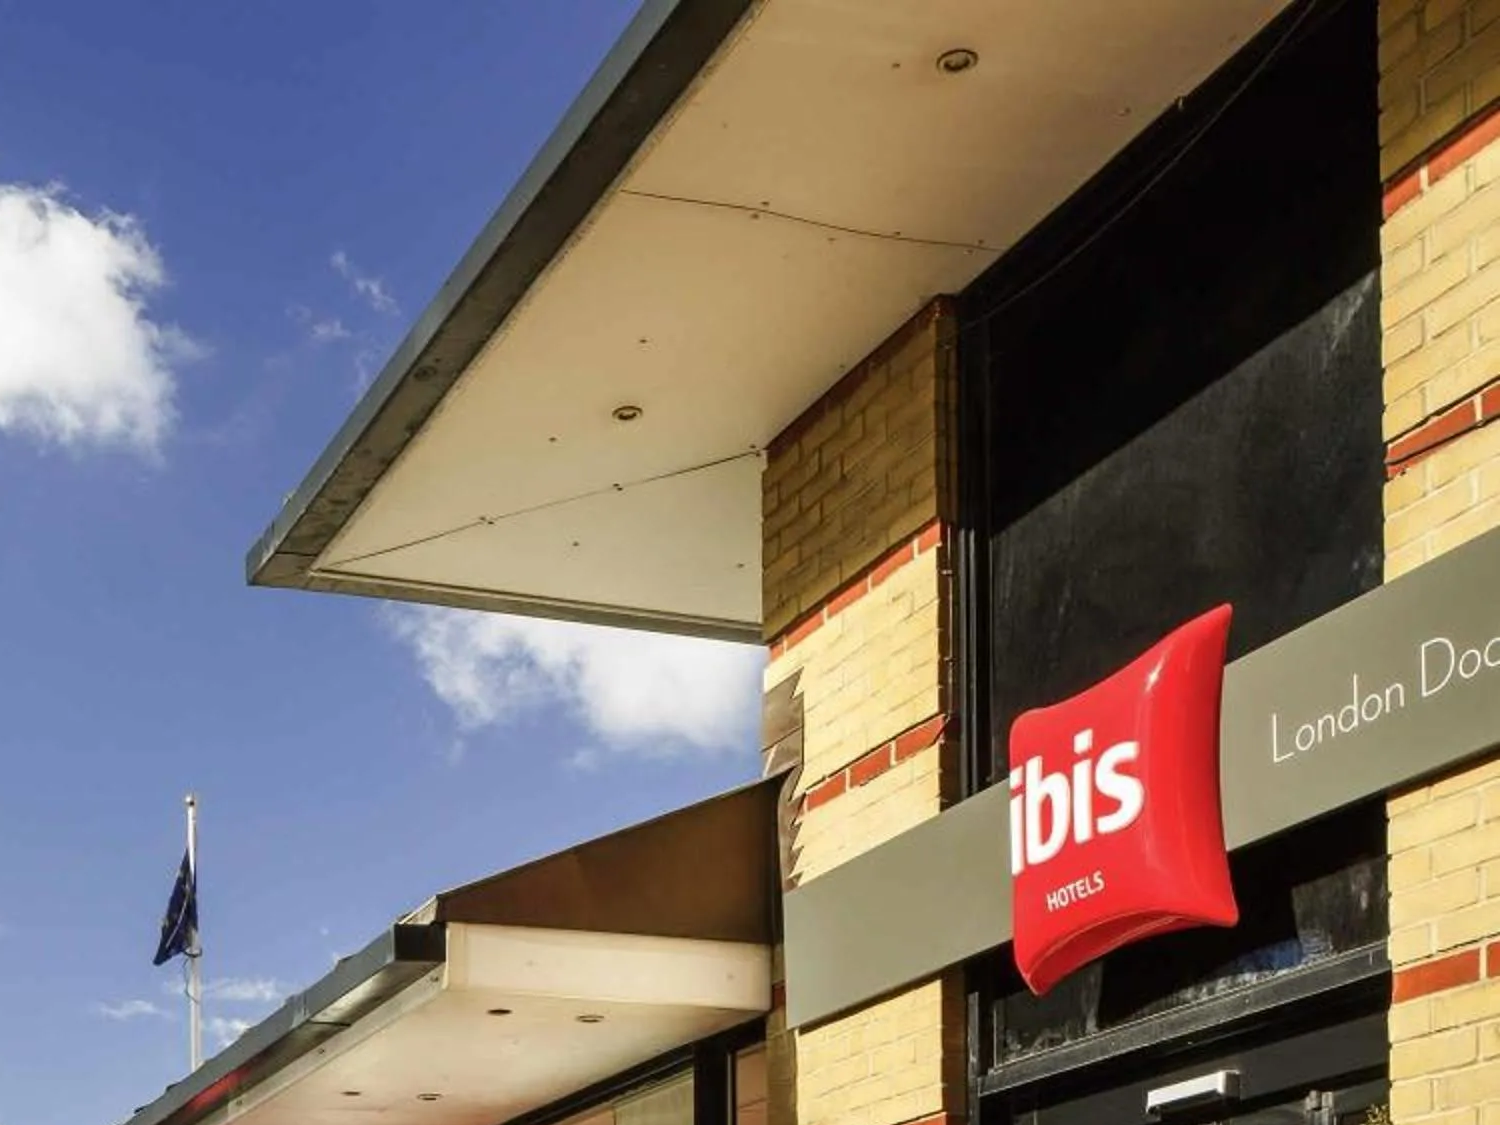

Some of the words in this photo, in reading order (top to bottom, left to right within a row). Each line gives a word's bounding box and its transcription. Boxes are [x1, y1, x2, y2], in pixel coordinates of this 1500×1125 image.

[1272, 673, 1405, 763] London
[1010, 728, 1145, 876] ibis
[1046, 869, 1105, 912] HOTELS
